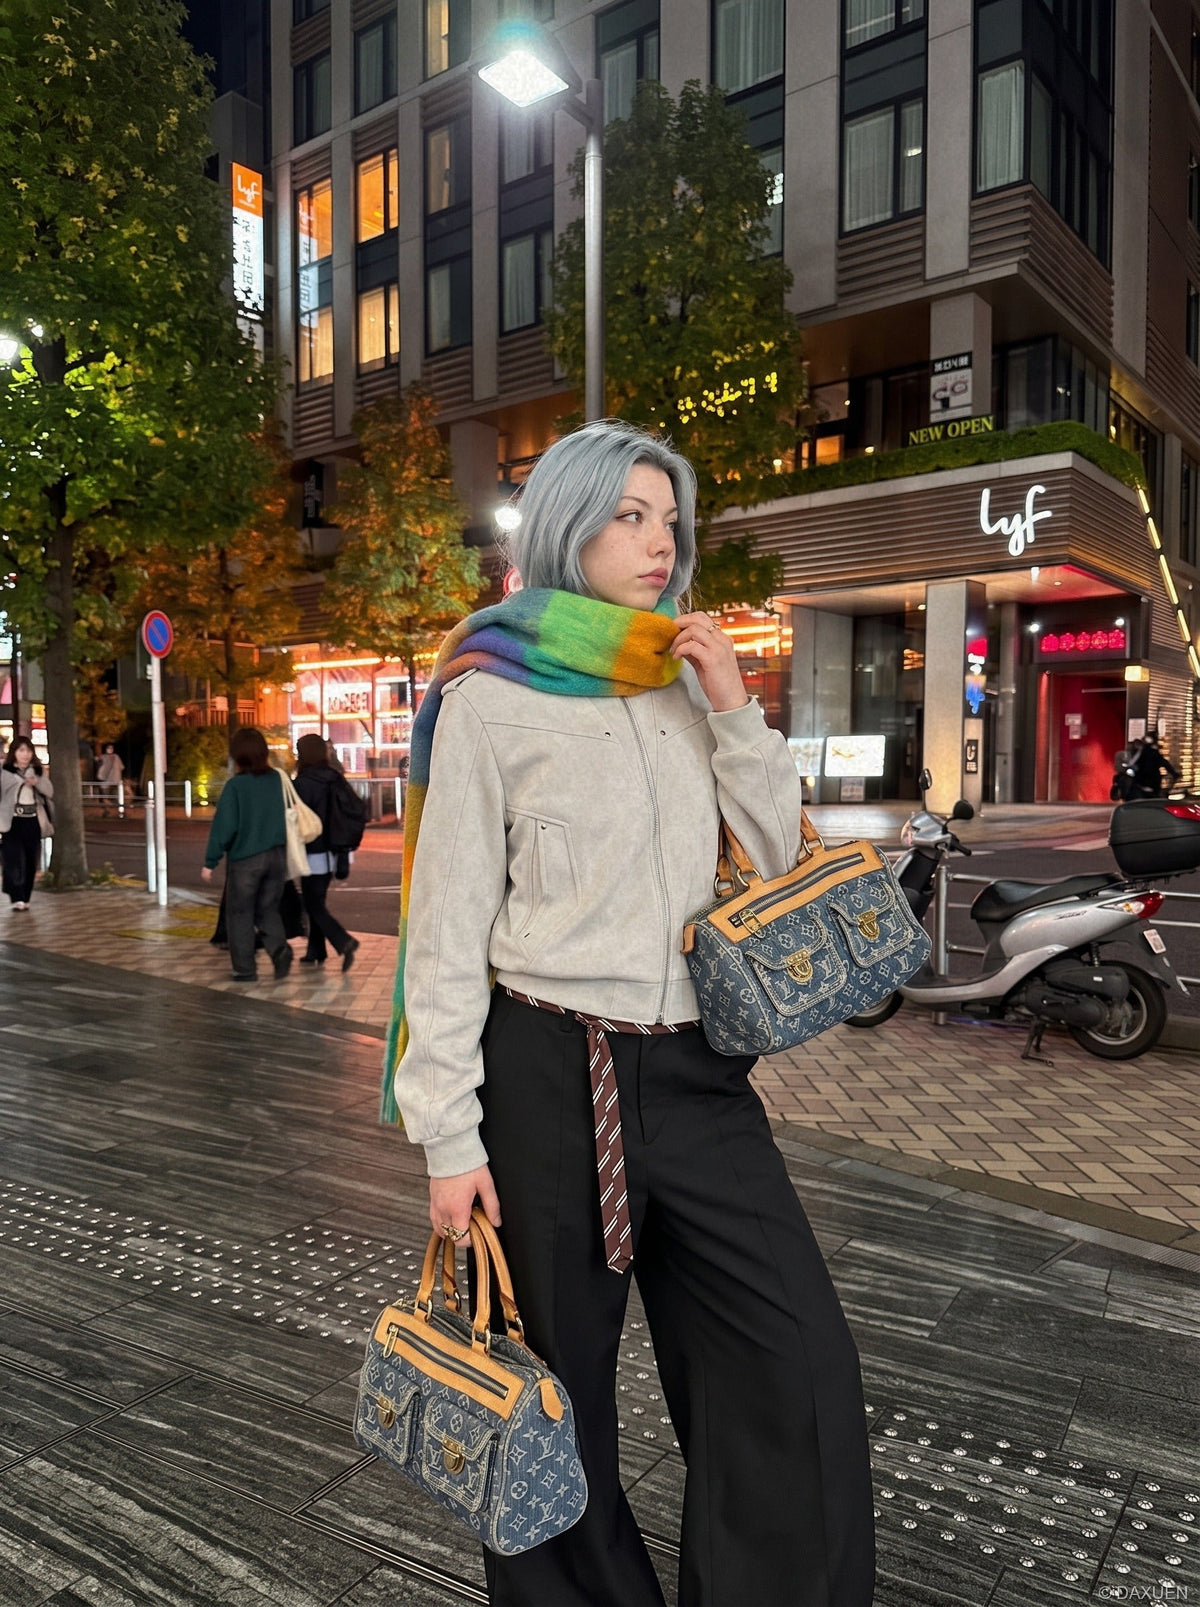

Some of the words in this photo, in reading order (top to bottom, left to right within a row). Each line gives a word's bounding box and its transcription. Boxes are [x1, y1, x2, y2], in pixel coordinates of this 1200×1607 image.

[237, 174, 261, 204] lyf
[909, 425, 944, 445] NEW
[947, 416, 994, 438] OPEN
[980, 485, 1053, 557] lyf
